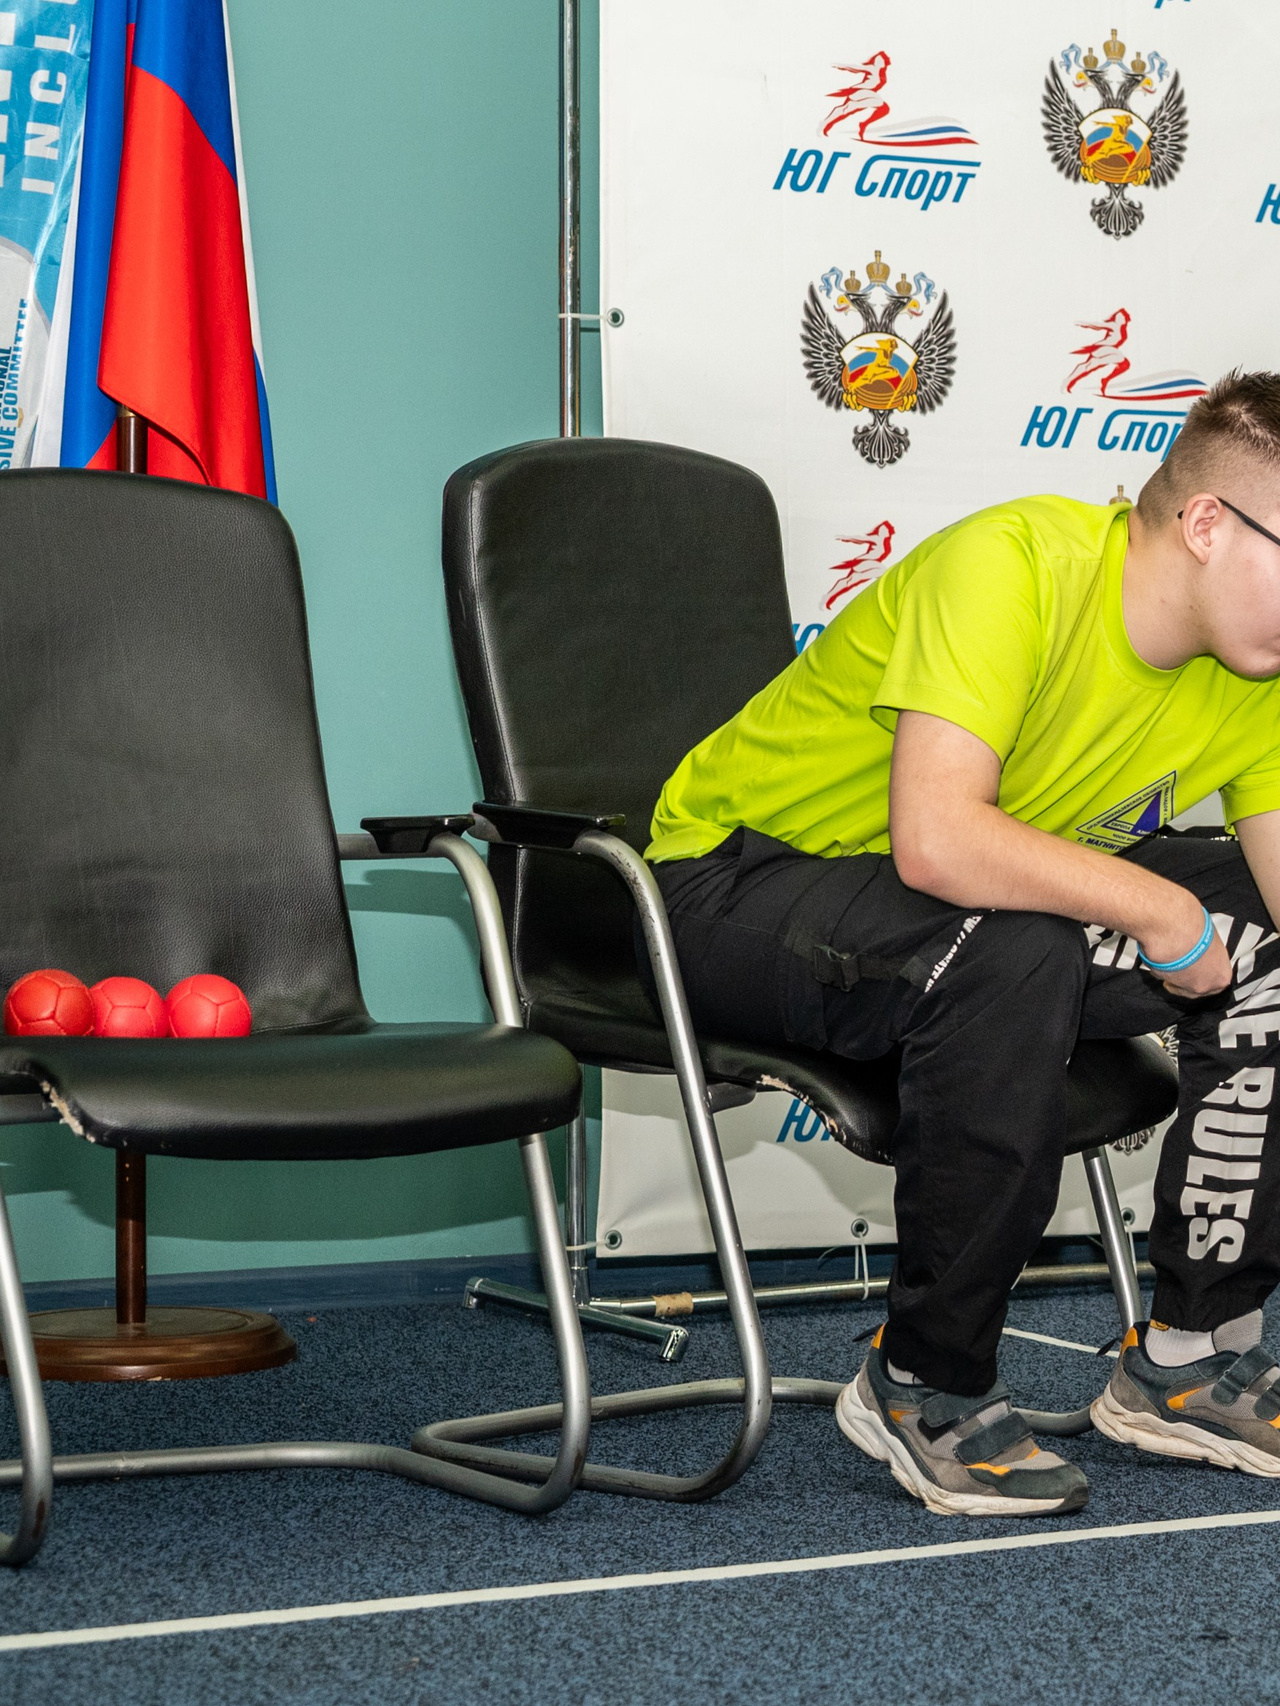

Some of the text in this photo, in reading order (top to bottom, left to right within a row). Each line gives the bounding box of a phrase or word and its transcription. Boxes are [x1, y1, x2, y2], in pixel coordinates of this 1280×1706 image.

[21, 0, 78, 195] INCL
[774, 148, 982, 212] ЮГ Спорт
[1020, 405, 1094, 449] ЮГ
[776, 1098, 831, 1143] Ю
[1180, 1066, 1276, 1263] RULES
